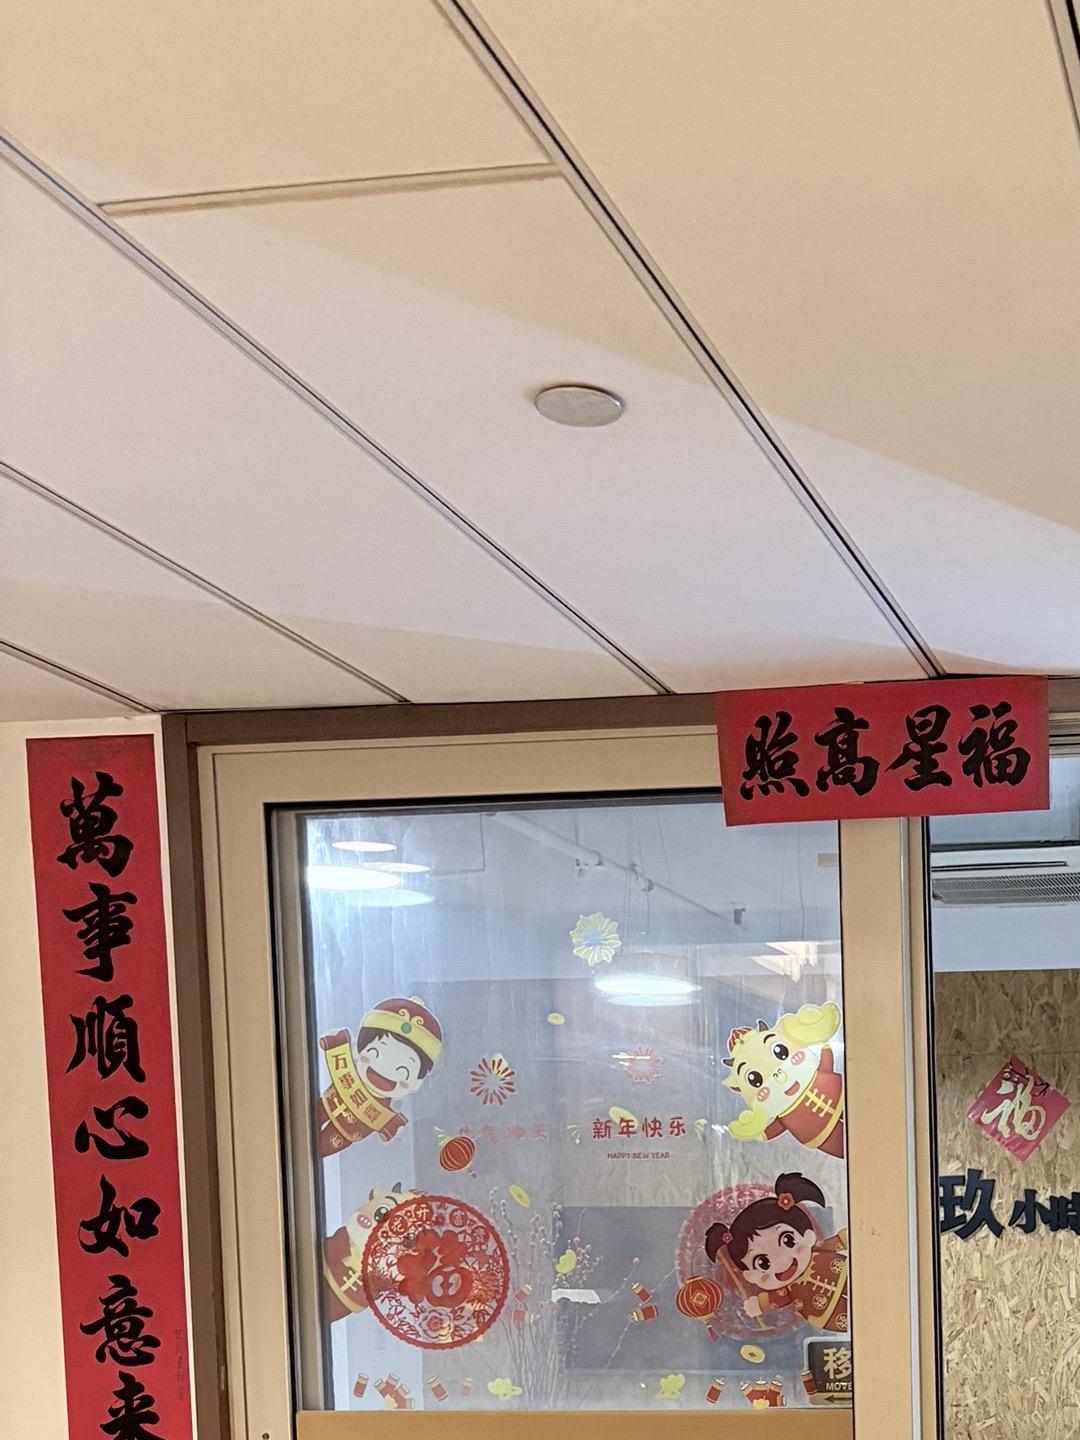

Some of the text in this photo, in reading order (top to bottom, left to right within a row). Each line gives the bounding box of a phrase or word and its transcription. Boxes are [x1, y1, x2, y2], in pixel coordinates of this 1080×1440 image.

[592, 1116, 687, 1139] 新年快乐
[651, 1152, 671, 1160] YEAR
